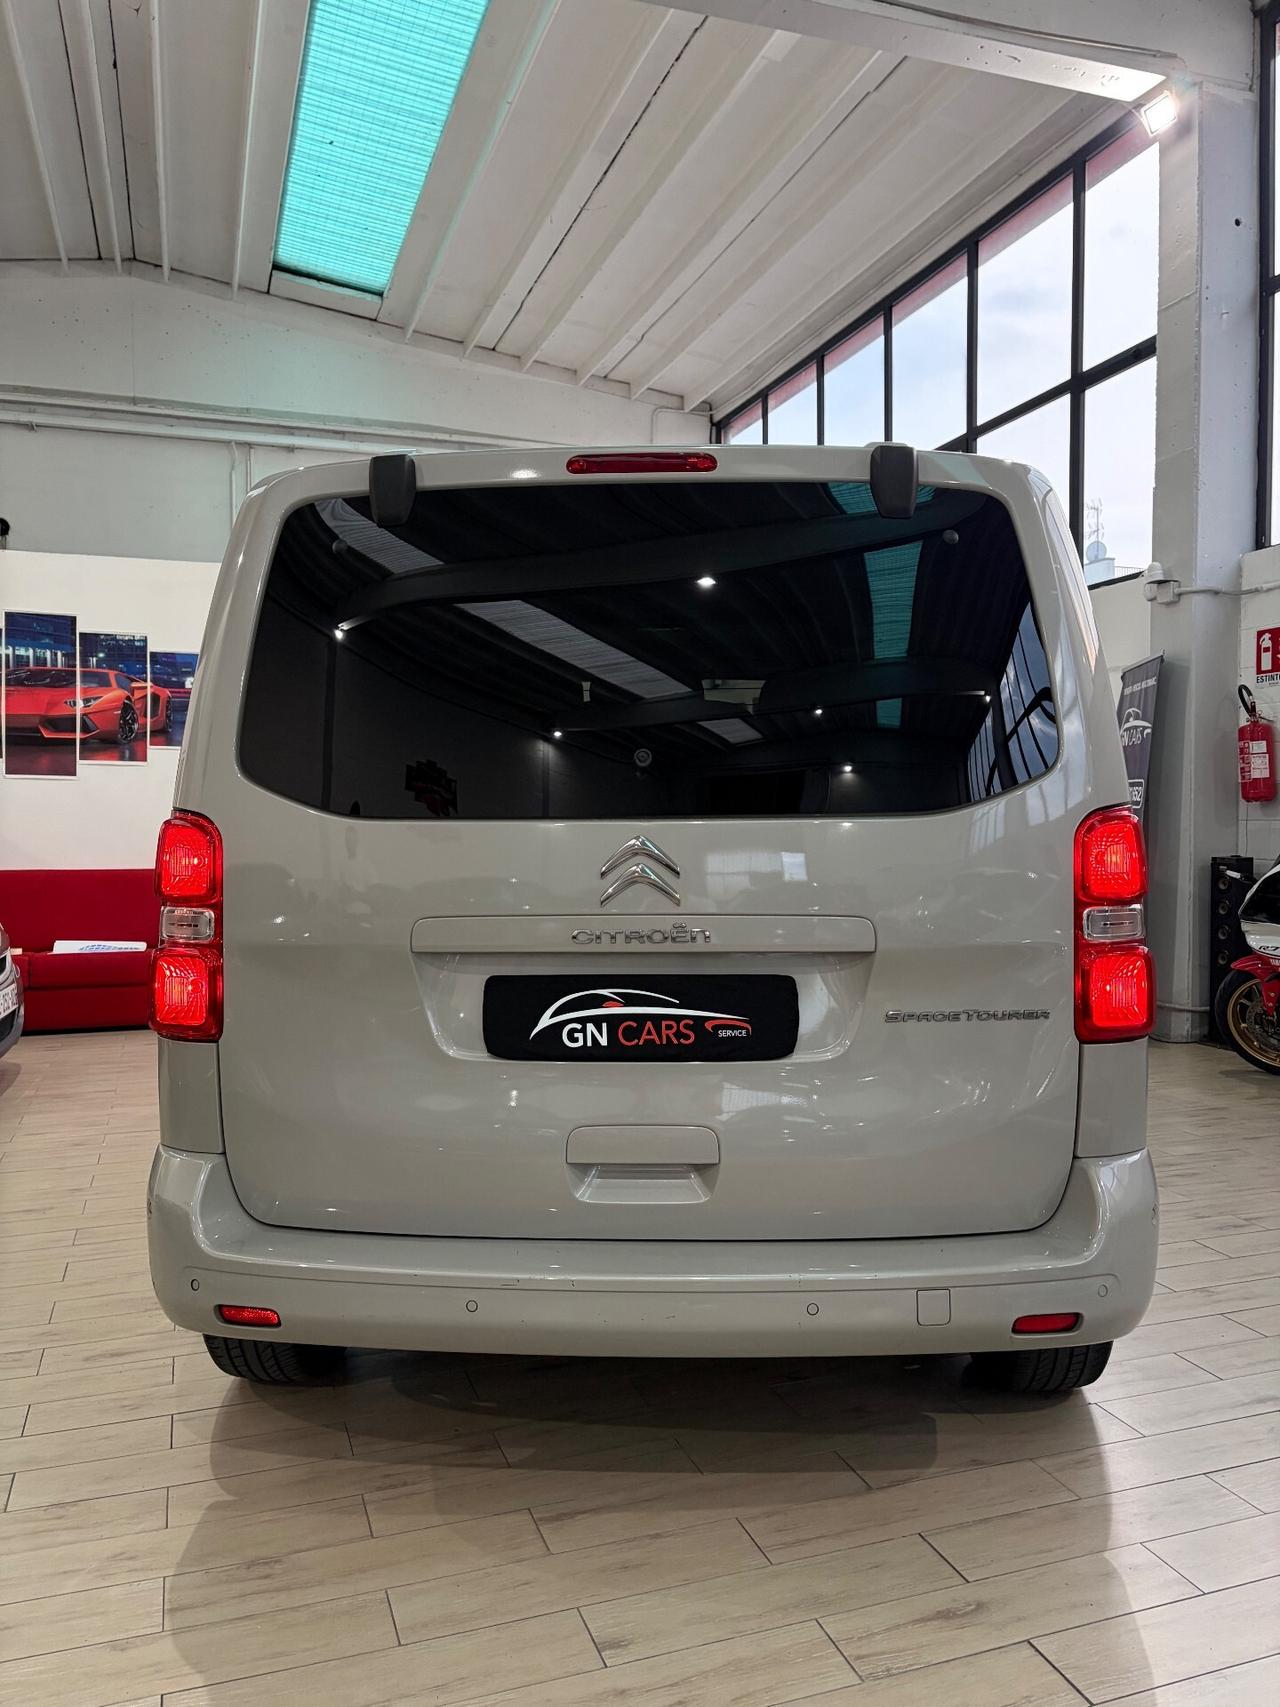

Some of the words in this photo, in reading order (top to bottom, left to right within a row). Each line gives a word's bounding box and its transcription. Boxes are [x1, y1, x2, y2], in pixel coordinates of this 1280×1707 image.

[1256, 673, 1280, 684] ESTINT
[885, 1009, 1050, 1023] SPACETOURER
[562, 1022, 608, 1048] GN
[617, 1020, 695, 1046] CARS
[717, 1029, 748, 1038] SERVICE
